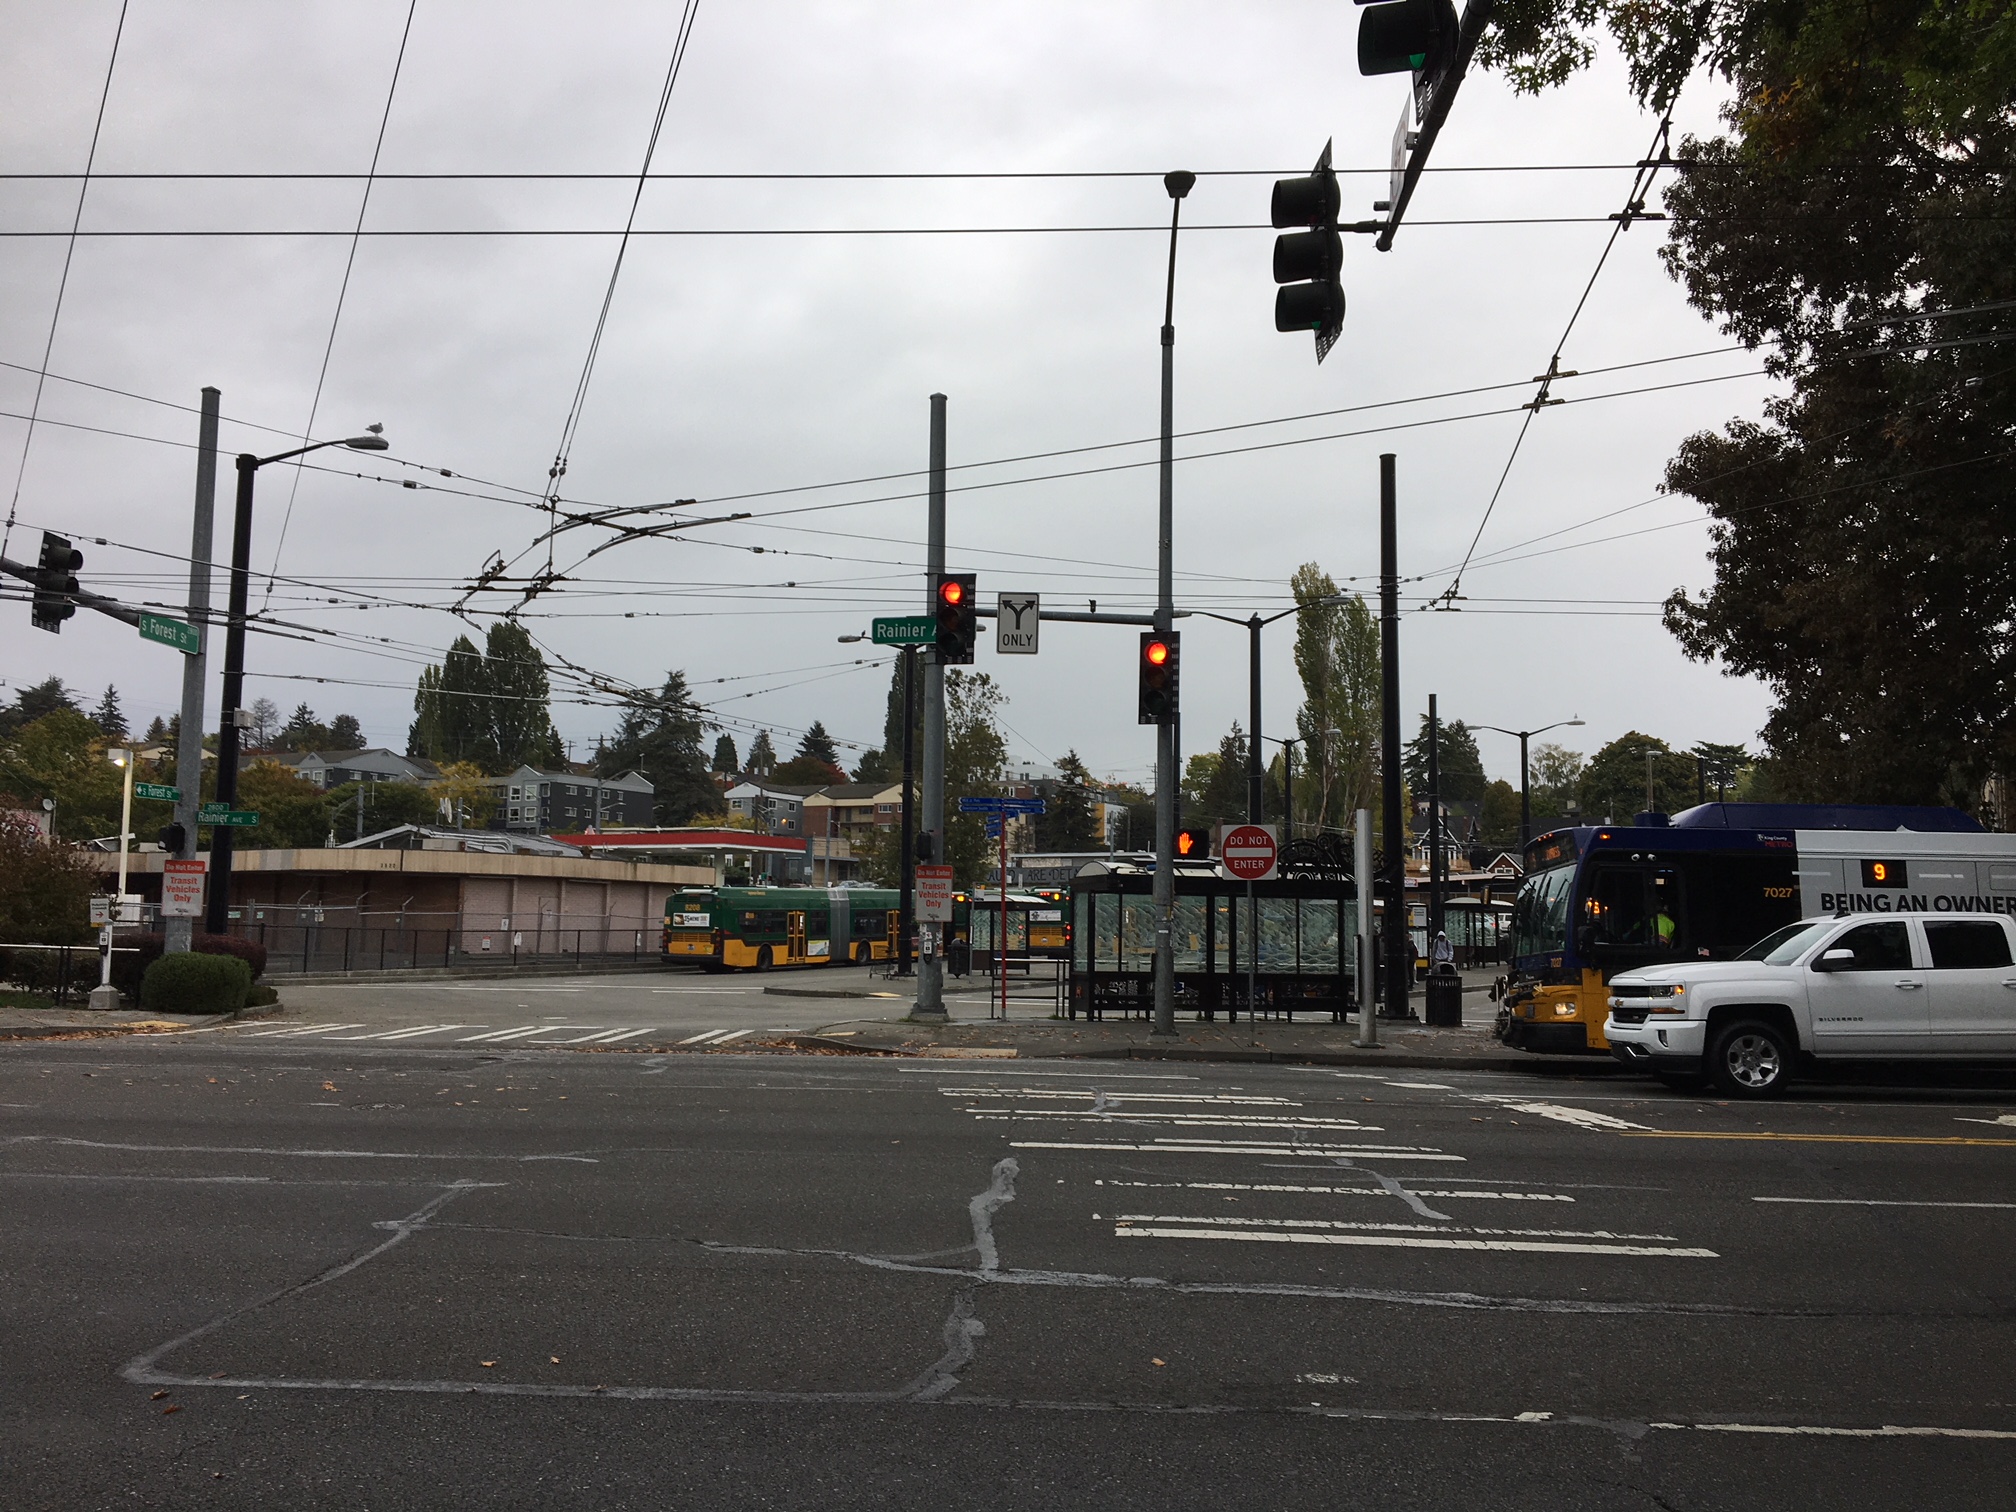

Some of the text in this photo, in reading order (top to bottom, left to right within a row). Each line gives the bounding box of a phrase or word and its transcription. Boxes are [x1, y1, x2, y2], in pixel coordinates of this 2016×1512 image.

[150, 619, 177, 641] Forest
[877, 624, 926, 638] Rainier
[1003, 634, 1033, 646] ONLY
[148, 785, 166, 797] Forest
[198, 811, 229, 823] Rainier
[252, 816, 257, 824] S
[1230, 836, 1268, 845] DO NOT
[1234, 860, 1265, 869] ENTER
[1873, 863, 1887, 881] 9
[171, 876, 198, 884] Transit
[174, 894, 191, 903] Only
[1763, 887, 1792, 898] 7027
[926, 900, 942, 908] Only
[1820, 893, 1891, 912] BEING
[1895, 895, 1928, 912] AN
